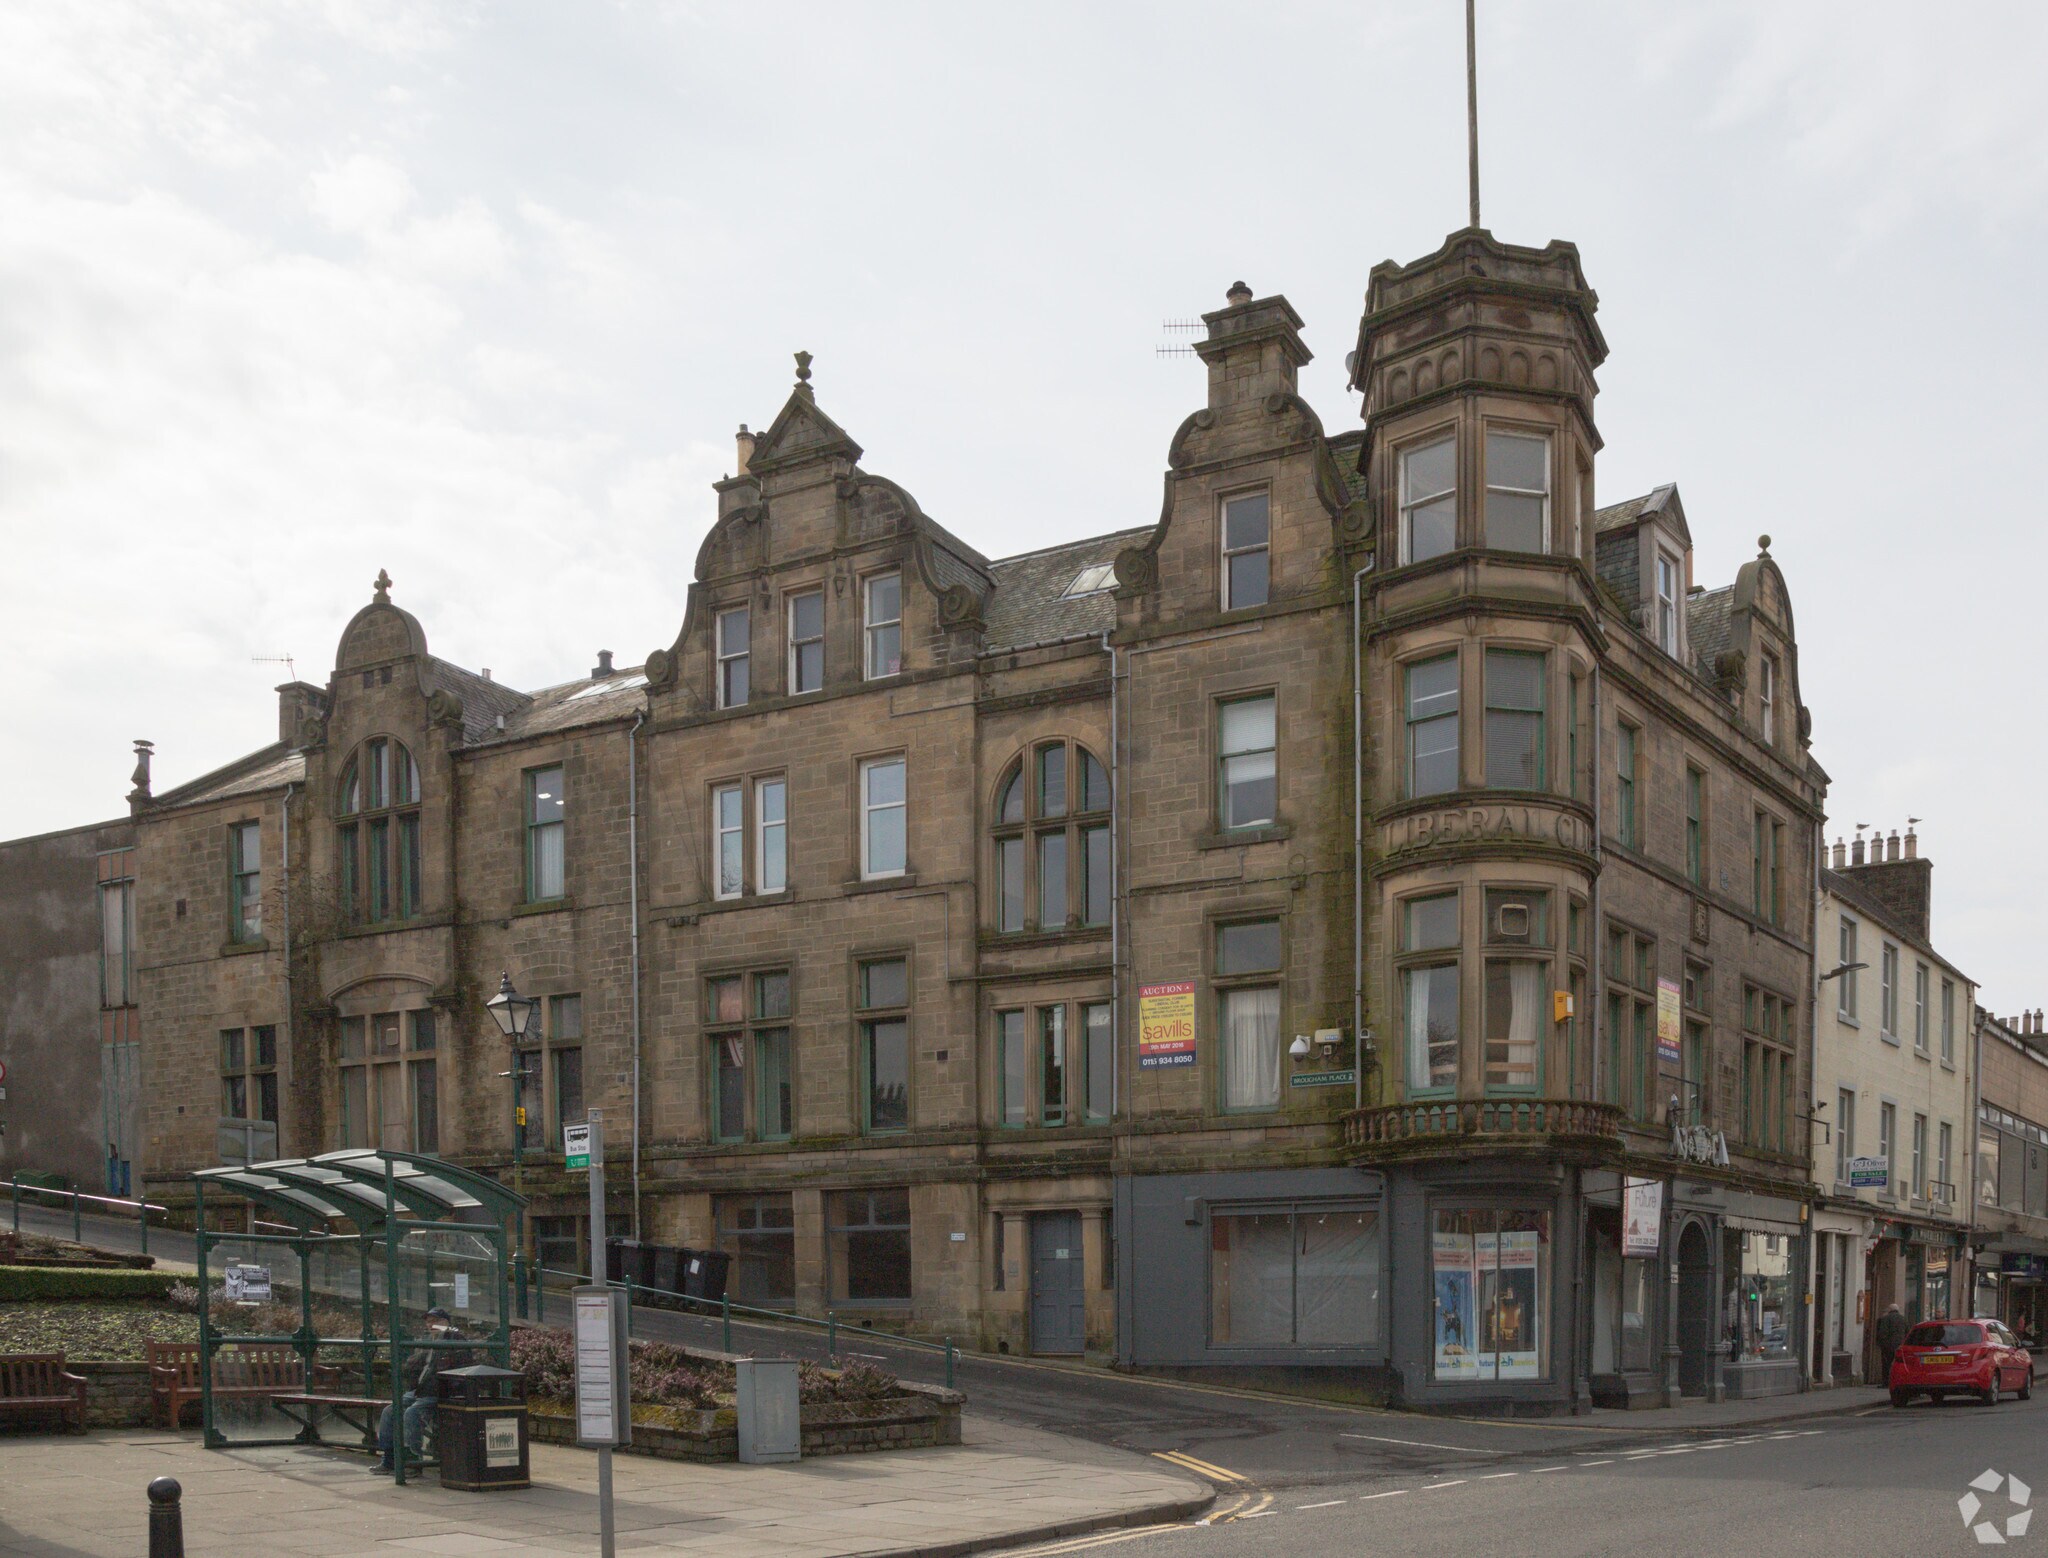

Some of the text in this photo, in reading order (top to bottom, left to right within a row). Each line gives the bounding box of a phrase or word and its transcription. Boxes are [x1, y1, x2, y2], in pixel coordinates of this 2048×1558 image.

[1385, 807, 1546, 857] LIBERAL
[1143, 985, 1182, 995] AUCTION
[1142, 1020, 1192, 1040] savills
[1158, 1056, 1173, 1065] 934
[1174, 1055, 1192, 1064] 8050
[1293, 1073, 1347, 1084] BROUGHAM PLACE
